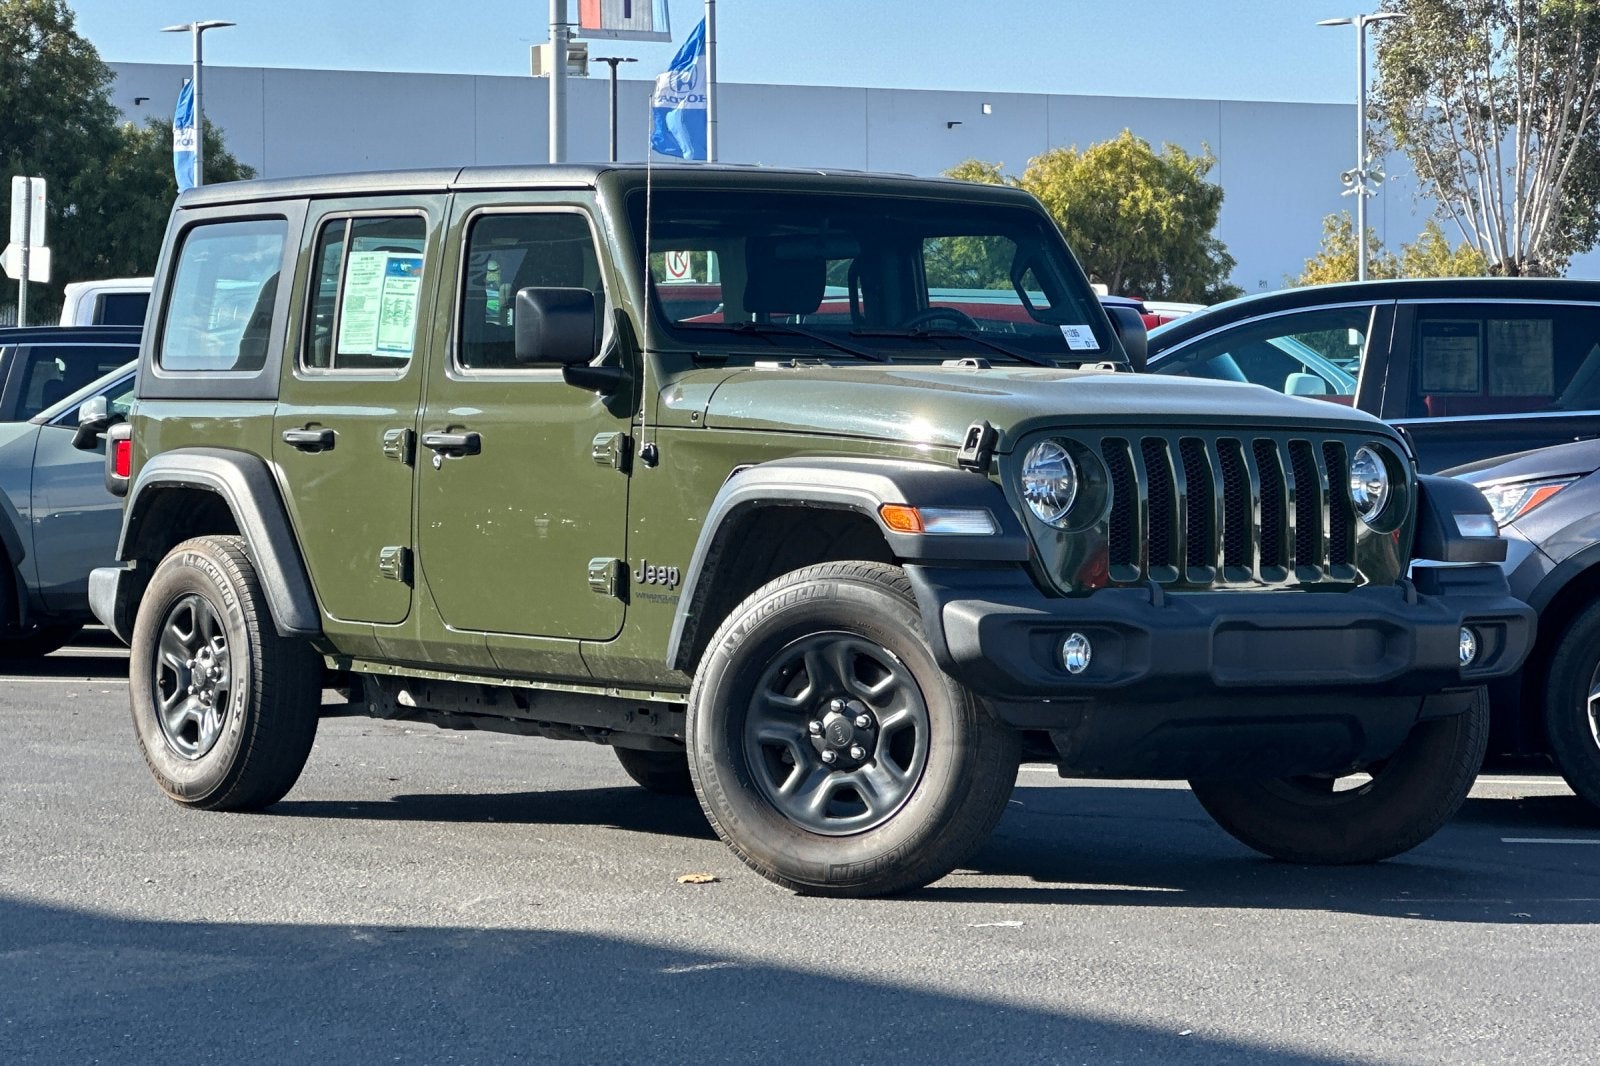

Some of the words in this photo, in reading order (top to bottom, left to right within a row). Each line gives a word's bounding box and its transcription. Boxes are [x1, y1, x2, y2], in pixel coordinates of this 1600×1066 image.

[195, 556, 234, 608] MICHELIN
[633, 558, 681, 591] Jeep
[742, 583, 831, 632] MICHELIN
